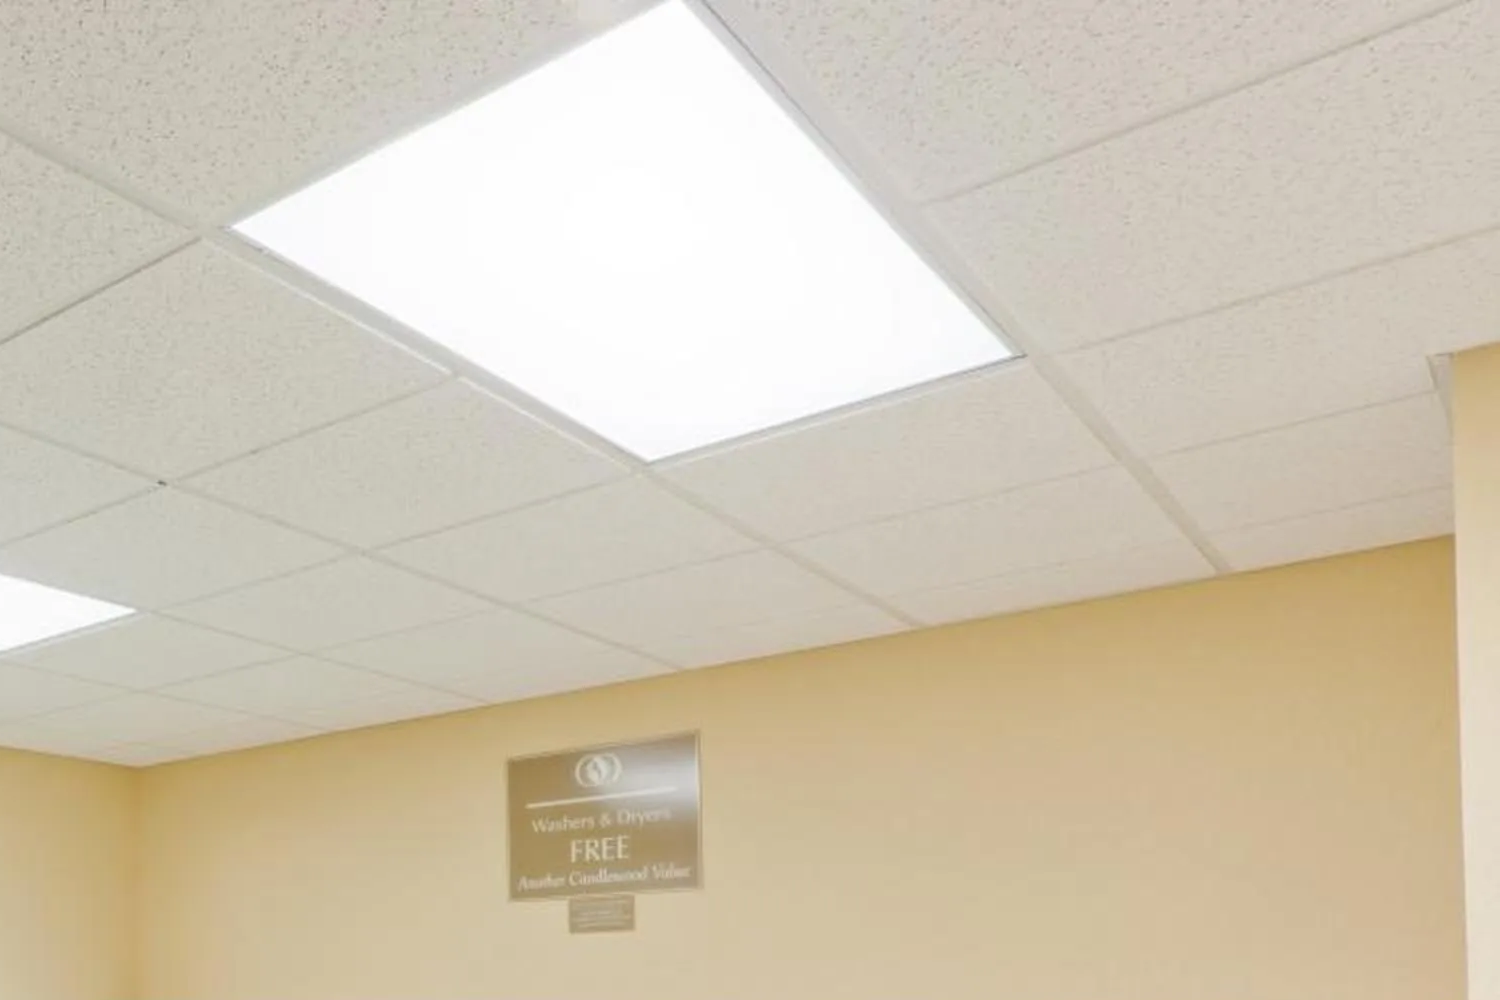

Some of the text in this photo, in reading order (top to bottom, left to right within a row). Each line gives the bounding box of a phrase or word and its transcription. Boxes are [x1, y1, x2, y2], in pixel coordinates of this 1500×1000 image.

[532, 814, 595, 833] Washers
[599, 813, 612, 826] &
[570, 835, 630, 863] FREE
